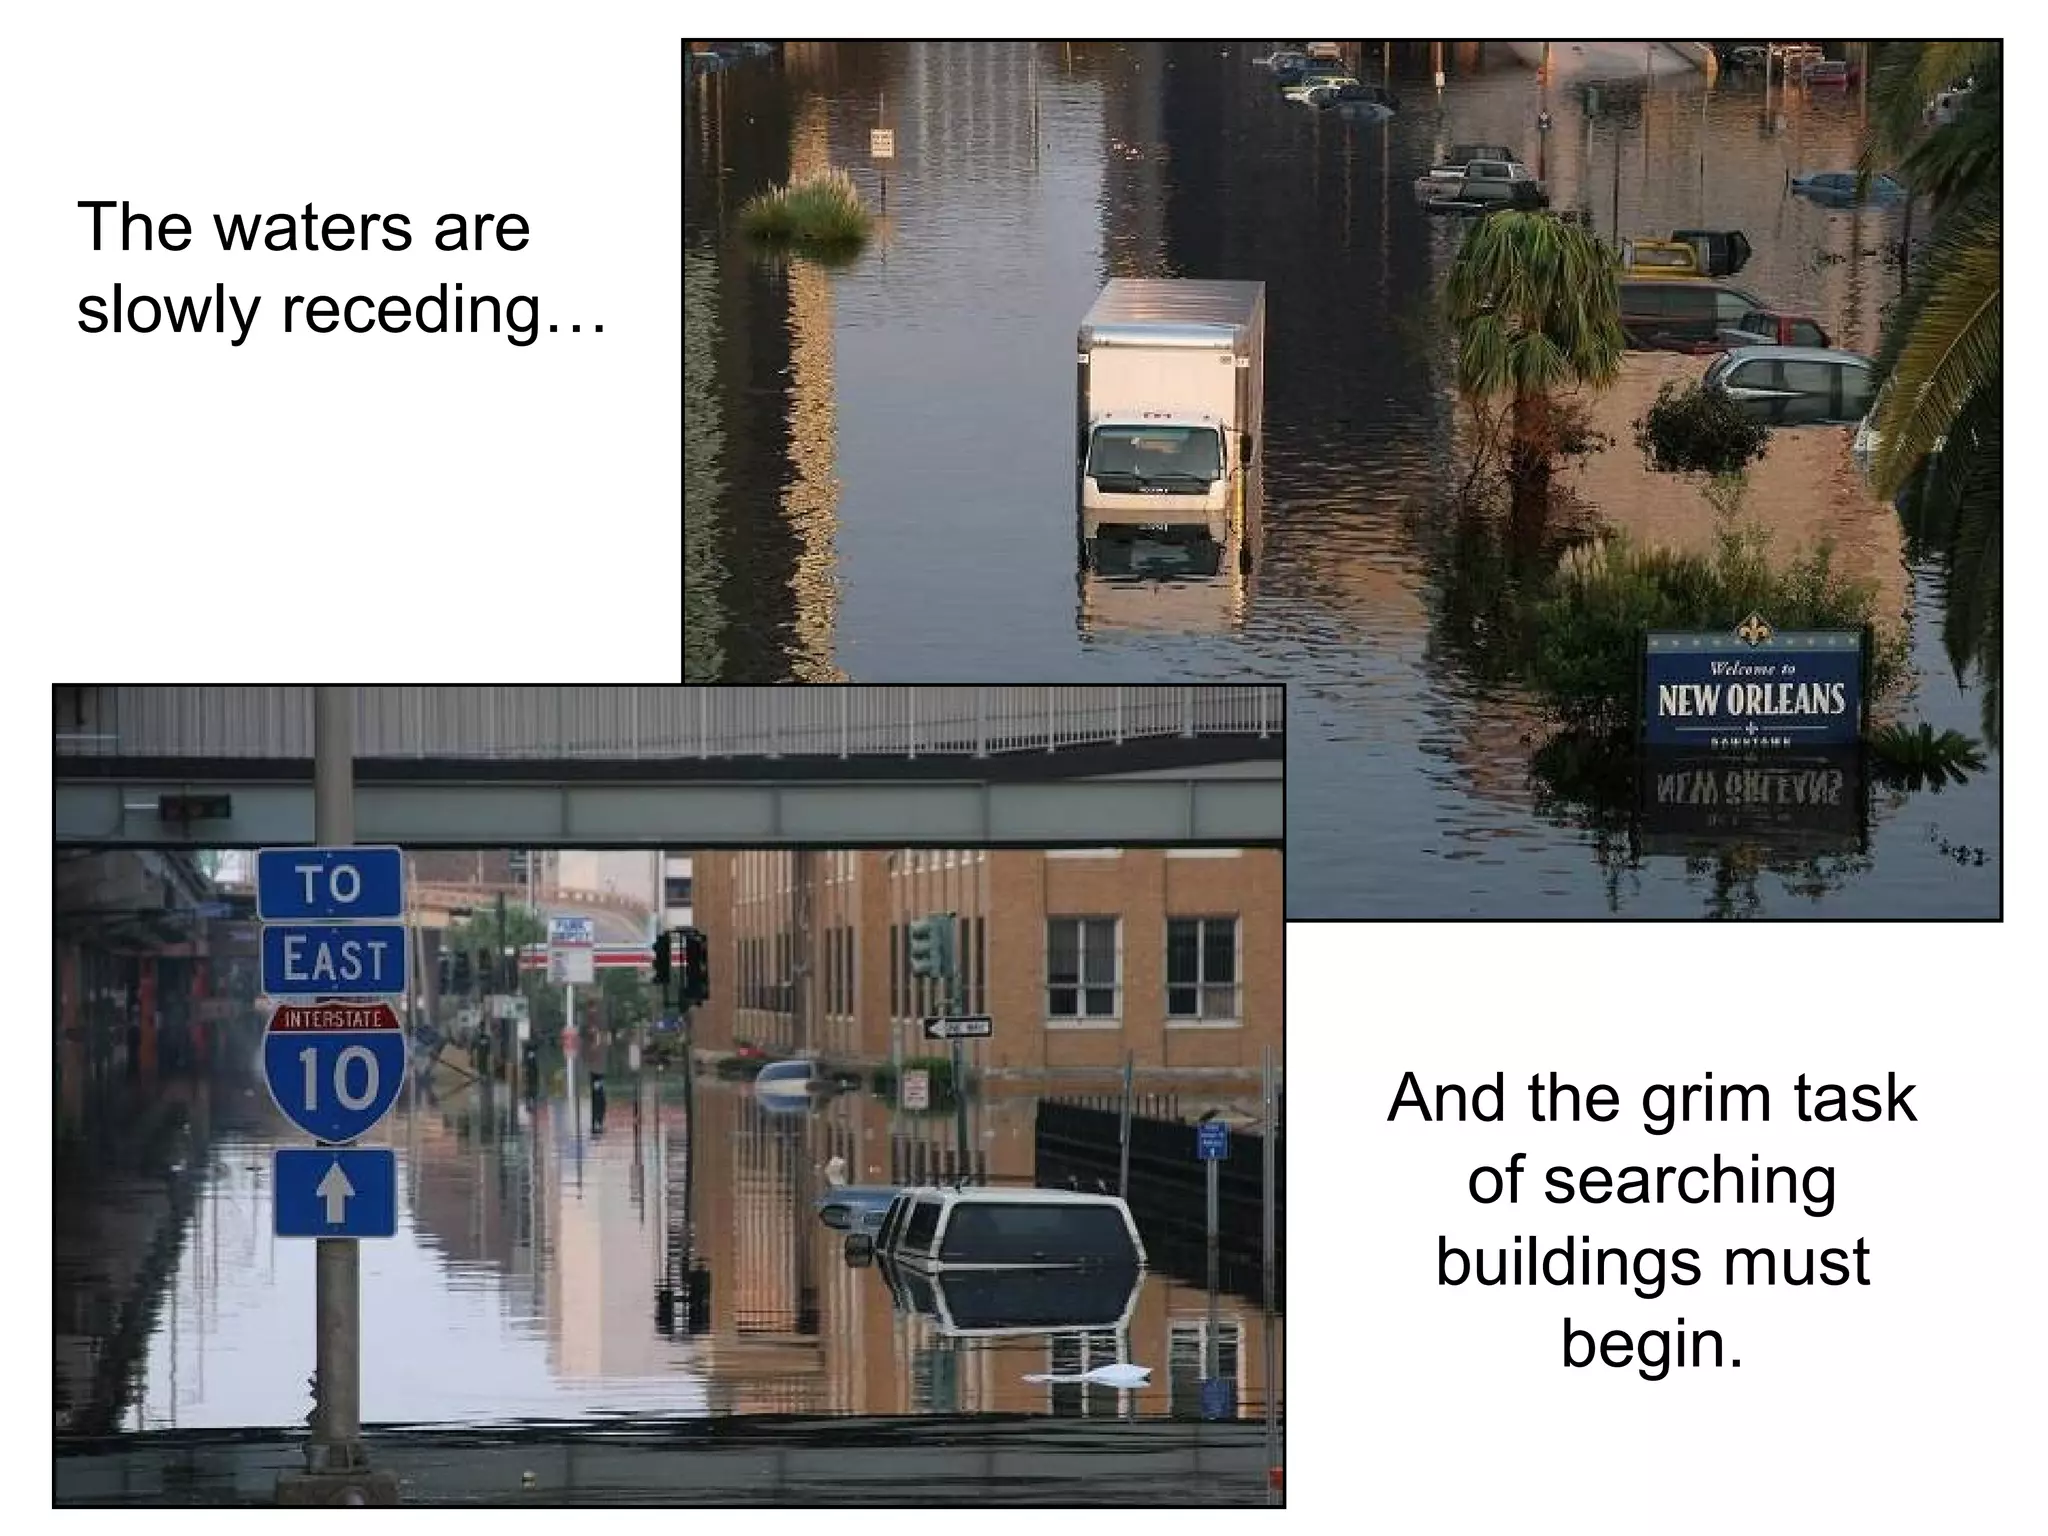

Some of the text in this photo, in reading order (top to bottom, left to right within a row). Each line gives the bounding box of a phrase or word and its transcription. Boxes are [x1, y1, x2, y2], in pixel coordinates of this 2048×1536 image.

[1711, 661, 1796, 676] Welcome to
[1658, 683, 1846, 716] NEW ORLEANS
[295, 865, 361, 903] TO
[284, 934, 388, 981] EAST
[285, 1010, 382, 1028] INTERSTATE
[299, 1045, 379, 1111] 10
